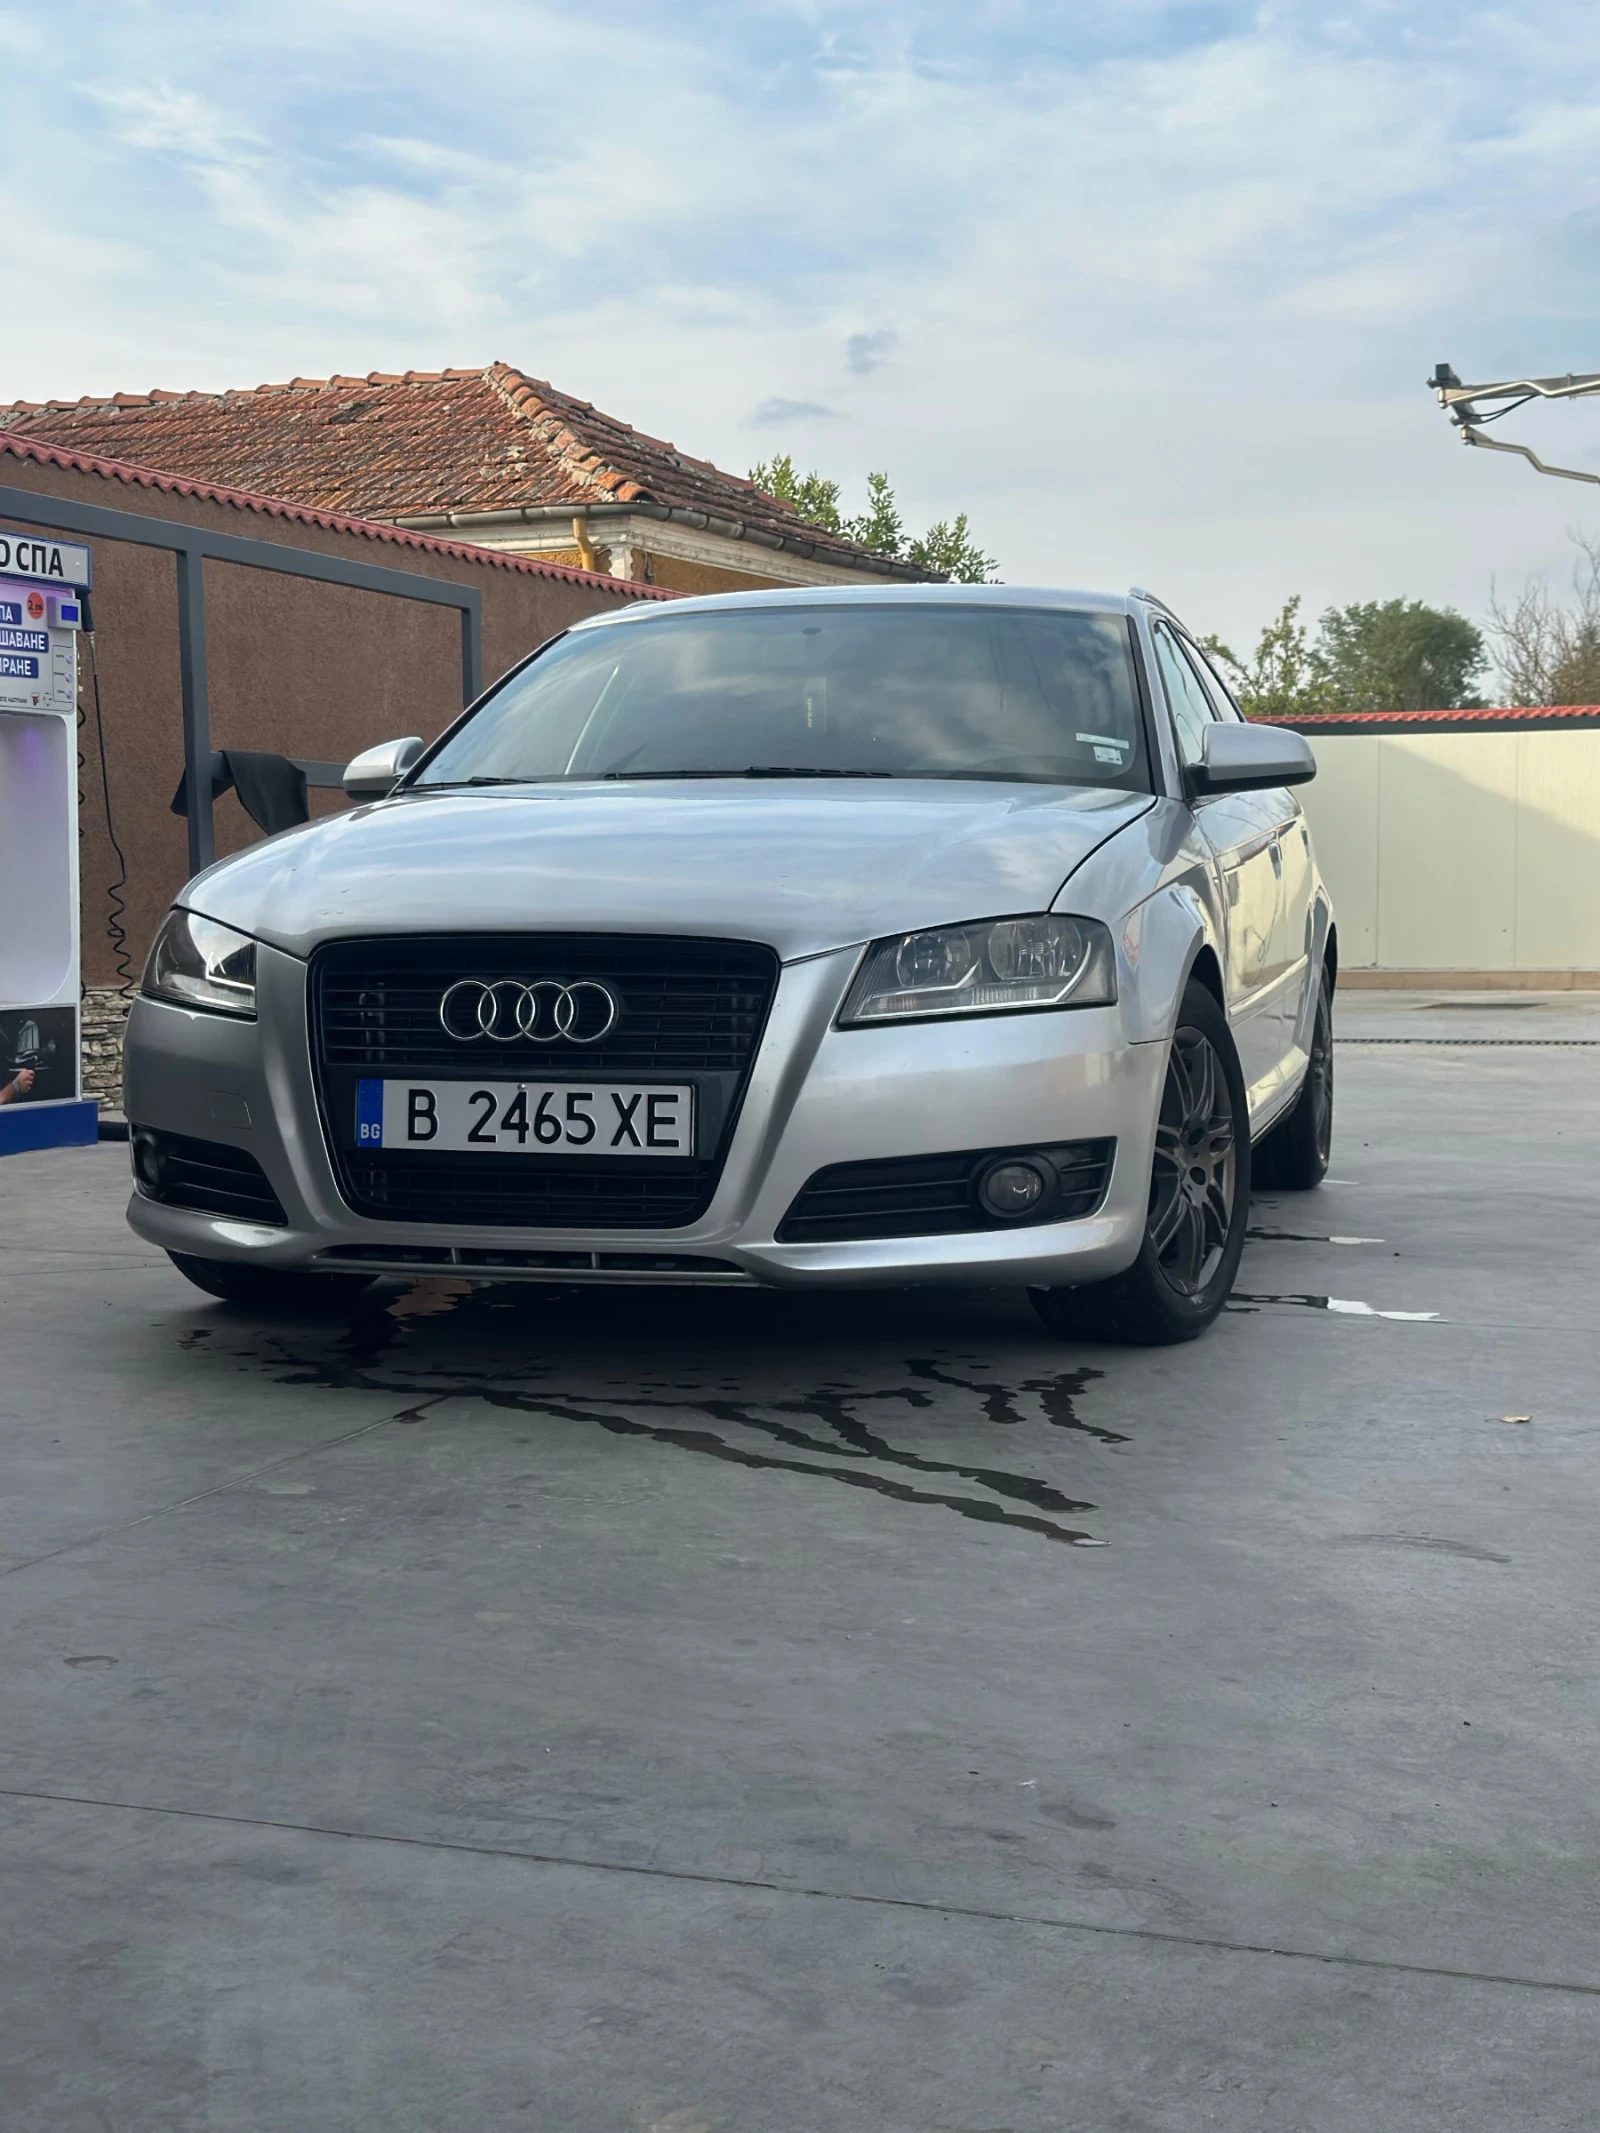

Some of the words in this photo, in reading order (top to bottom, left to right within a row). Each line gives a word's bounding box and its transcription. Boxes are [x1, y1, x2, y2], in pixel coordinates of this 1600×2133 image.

[16, 542, 64, 578] СПА
[0, 630, 46, 650] ШАВАНЕ
[360, 1123, 381, 1140] BG
[408, 1089, 439, 1141] B
[467, 1089, 597, 1146] 2465
[609, 1092, 680, 1148] XE
